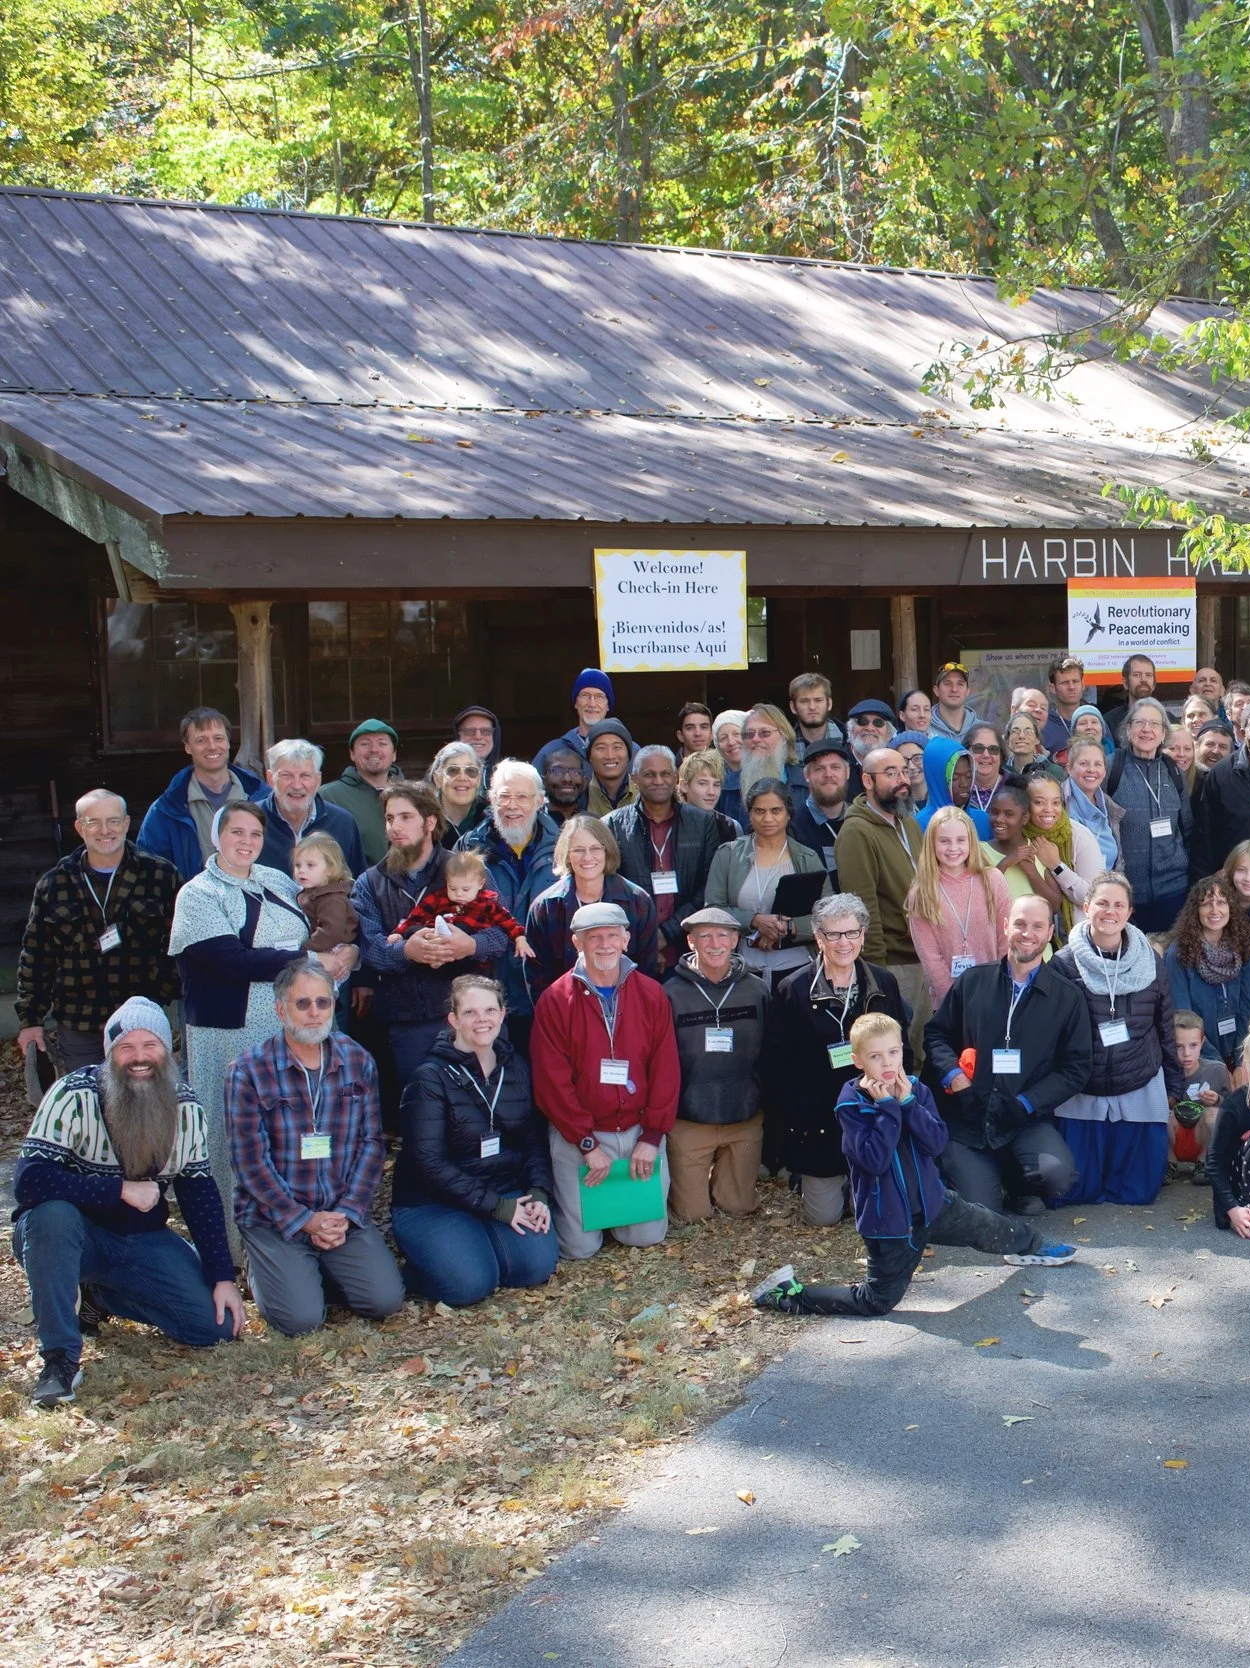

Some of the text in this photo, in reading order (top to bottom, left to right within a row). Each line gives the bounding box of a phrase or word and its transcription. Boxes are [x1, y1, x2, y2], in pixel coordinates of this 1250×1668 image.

[982, 537, 1135, 578] HARBIN
[633, 561, 704, 574] Welcome!
[617, 580, 719, 594] Check-in Here
[1107, 605, 1191, 619] Revolutionary
[611, 620, 726, 637] ¡Bienvenidos/as!
[1108, 622, 1190, 636] Peacemaking
[612, 641, 727, 657] Inscríbanse Aquí
[1157, 638, 1180, 646] conflict
[1037, 652, 1058, 661] you're
